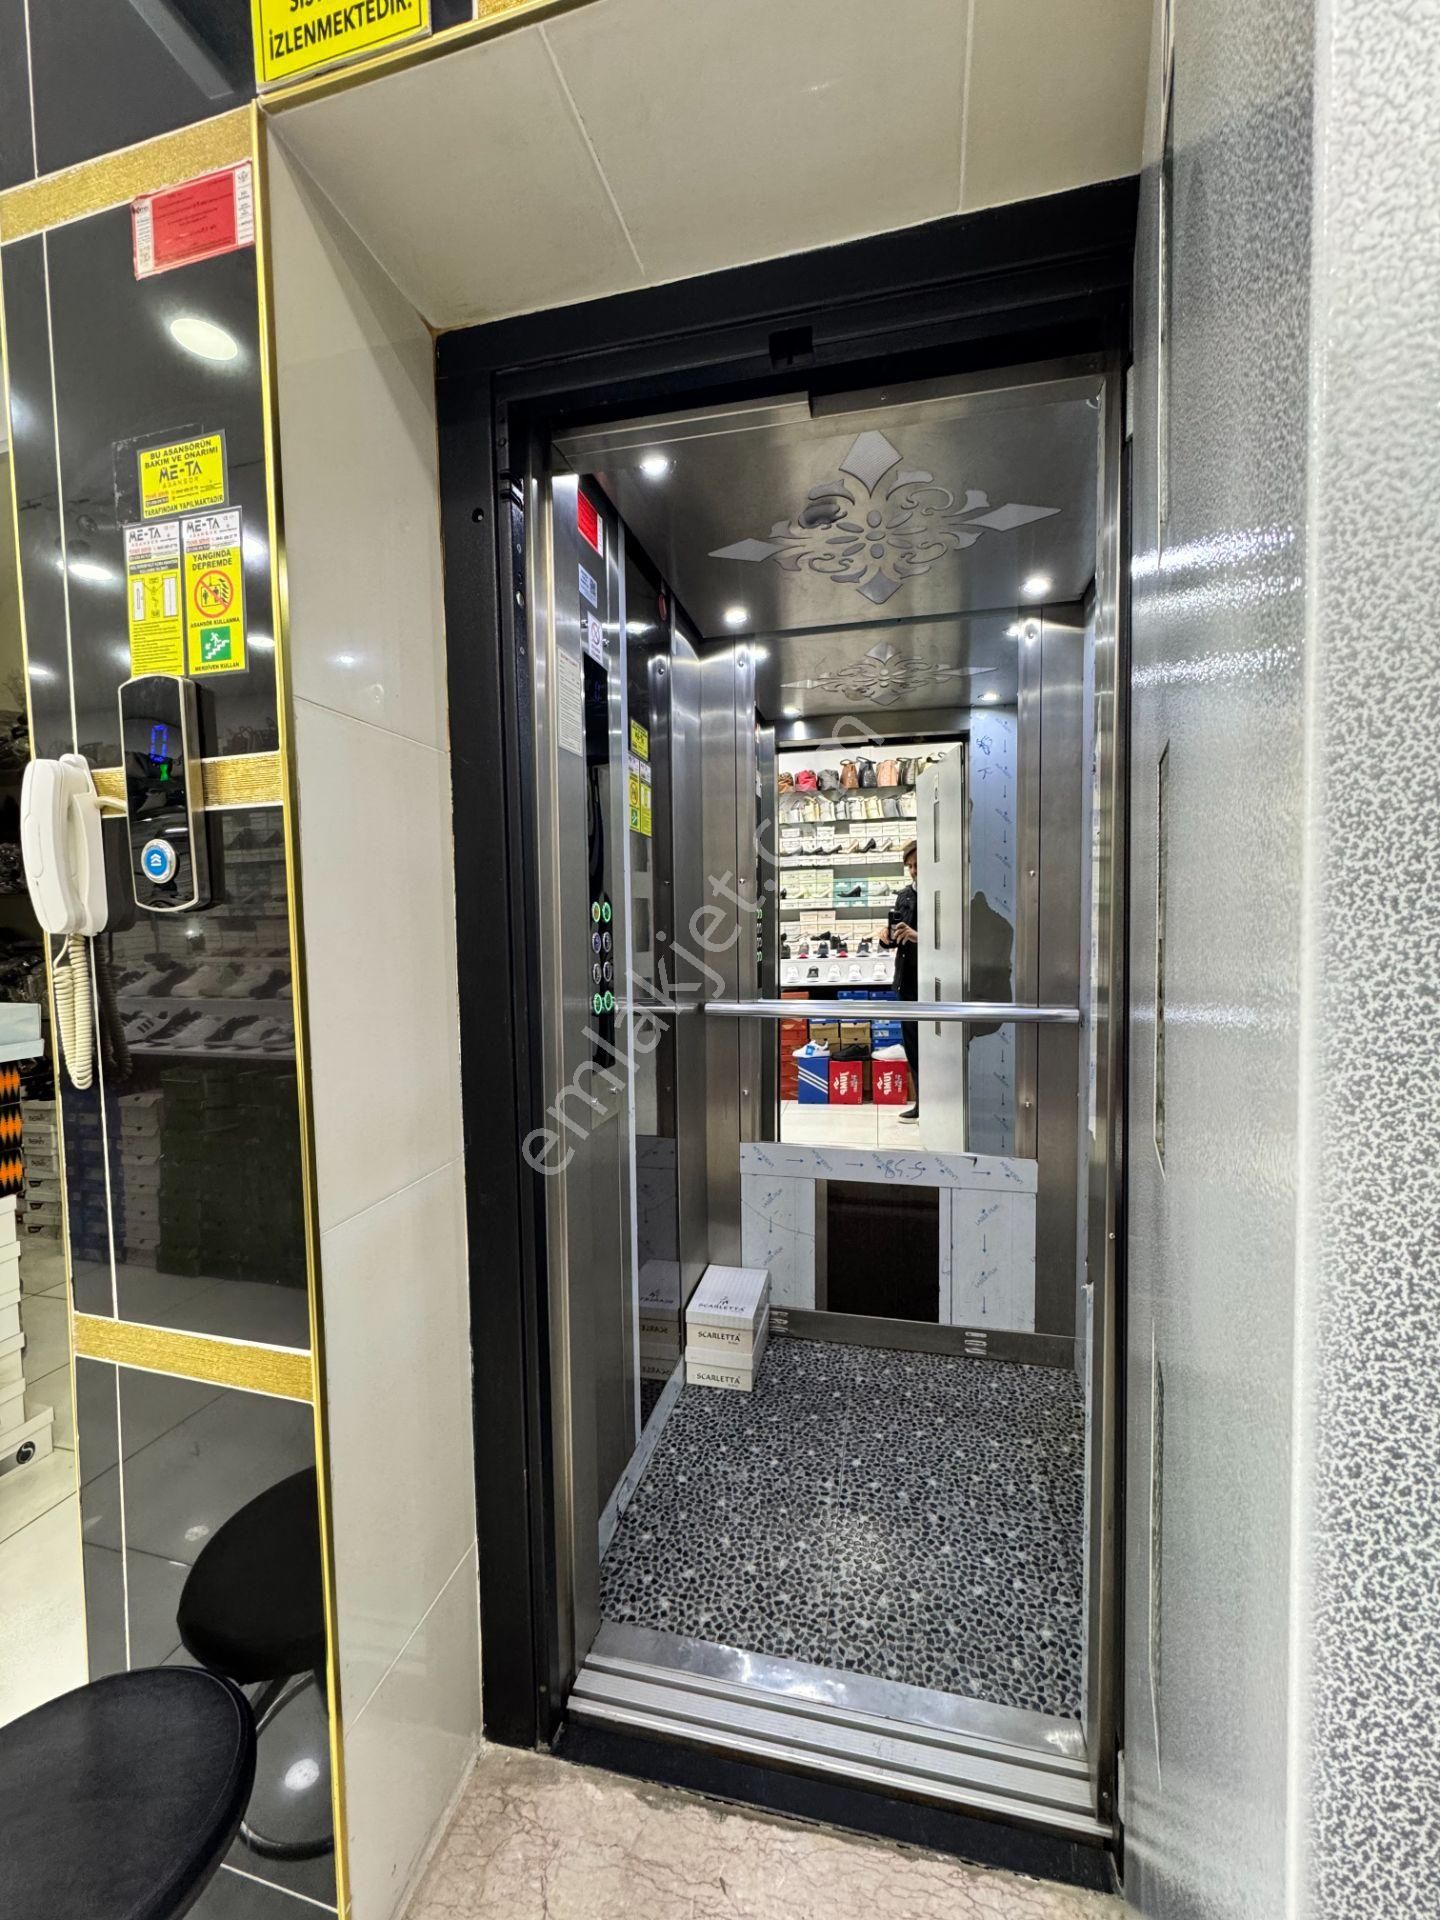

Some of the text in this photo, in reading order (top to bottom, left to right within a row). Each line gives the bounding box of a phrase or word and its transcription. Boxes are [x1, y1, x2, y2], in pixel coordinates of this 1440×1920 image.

[145, 446, 219, 469] BAKIM VE ONARIMI
[150, 452, 161, 460] BU
[192, 557, 233, 571] DEPREMDE
[698, 1331, 741, 1343] SCARLETTA
[696, 1373, 741, 1385] SCARLETTA
